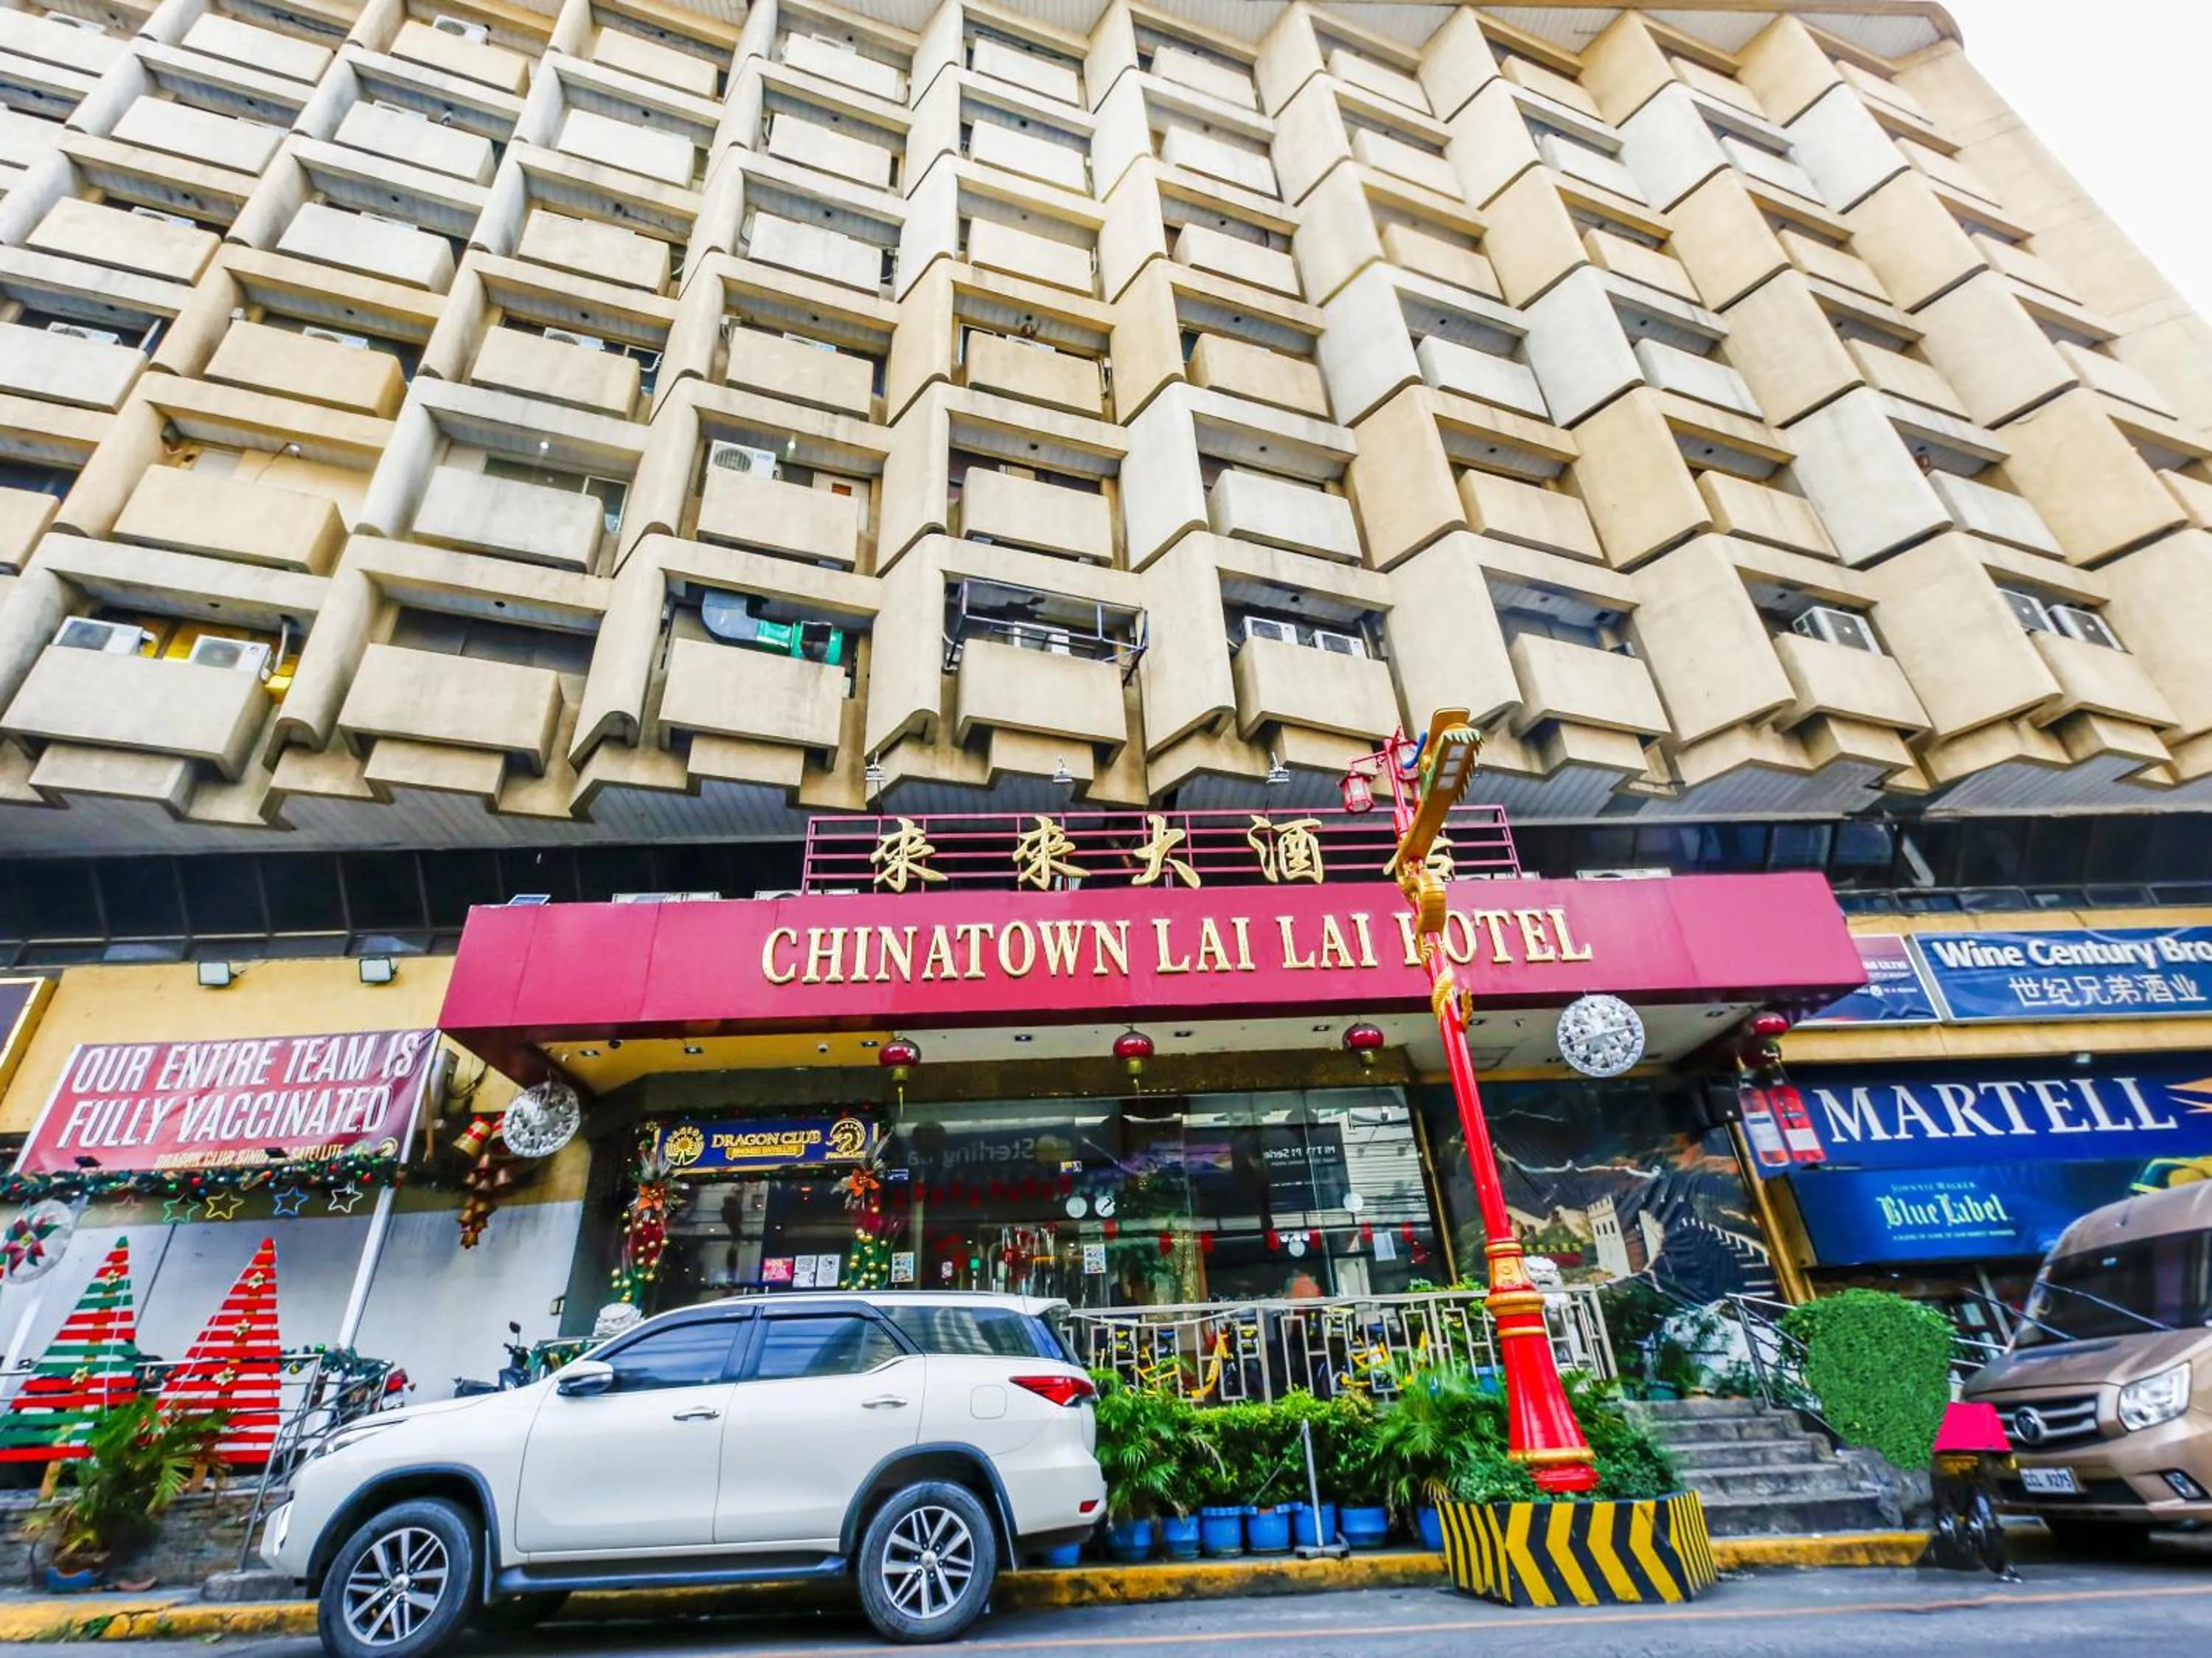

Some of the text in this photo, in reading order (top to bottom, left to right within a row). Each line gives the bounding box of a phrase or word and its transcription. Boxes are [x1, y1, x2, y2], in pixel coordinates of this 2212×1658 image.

[761, 919, 1132, 984] CHINATOWN
[1152, 917, 1256, 973] LAI
[1276, 912, 1379, 968] LAI
[1930, 936, 2212, 970] Wine Century Bro
[2008, 974, 2207, 1007] 世纪兄弟酒业
[71, 1032, 423, 1094] OUR ENTIRE TEAM IS
[56, 1085, 394, 1150] FULLY VACCINATED
[1812, 1077, 2178, 1143] MARTELL
[711, 1129, 822, 1148] DRAGON CLUB
[1875, 1193, 2008, 1229] Blue Label
